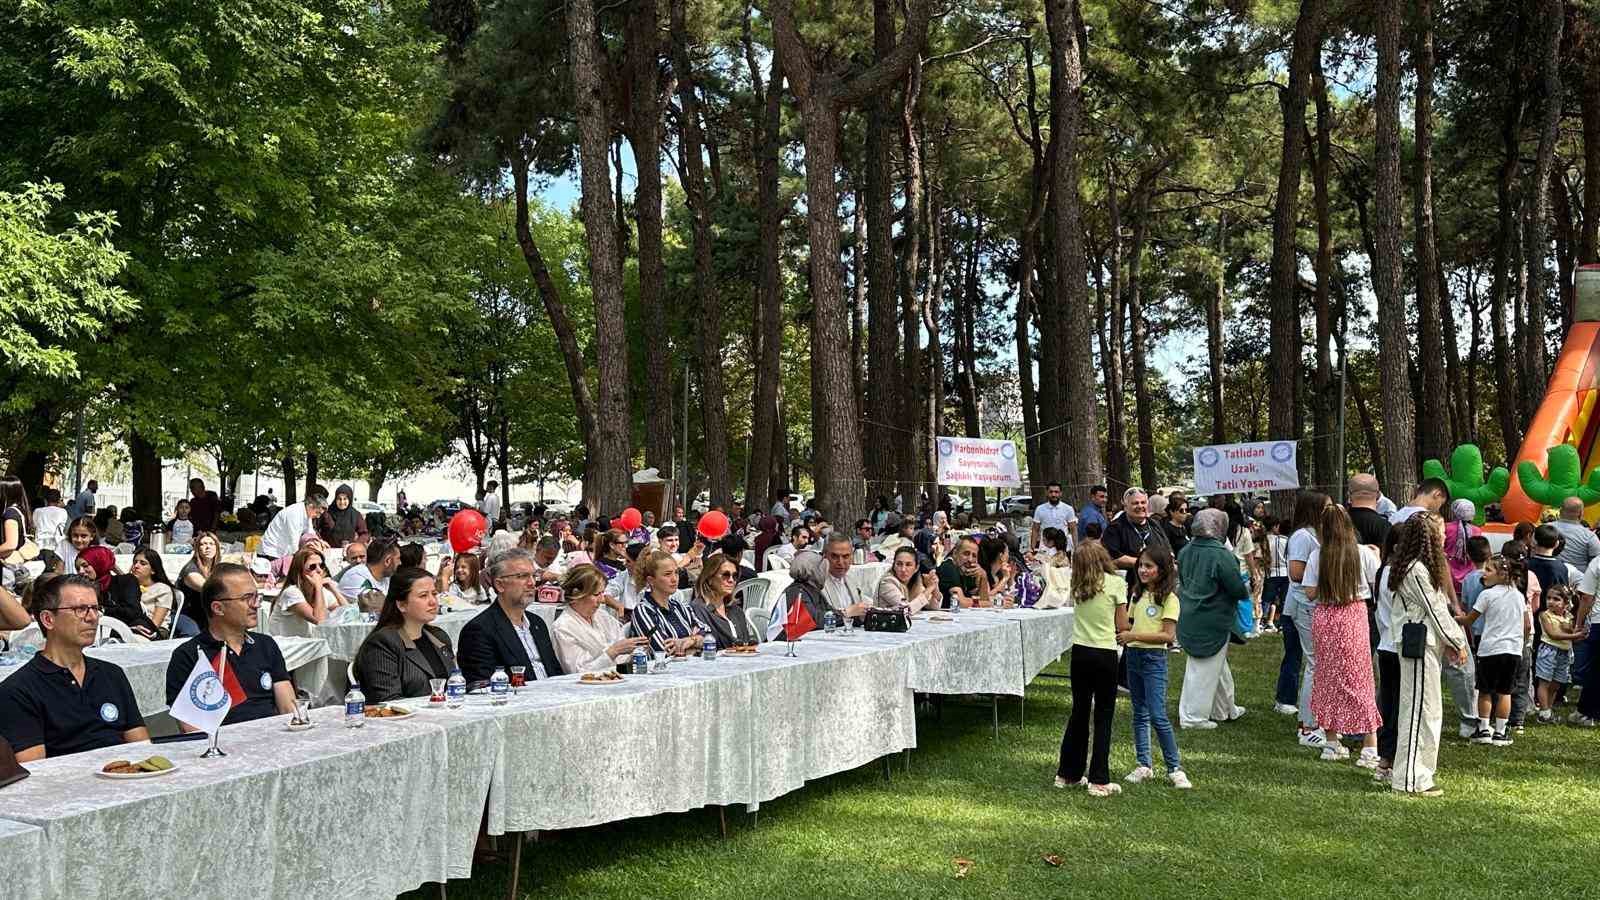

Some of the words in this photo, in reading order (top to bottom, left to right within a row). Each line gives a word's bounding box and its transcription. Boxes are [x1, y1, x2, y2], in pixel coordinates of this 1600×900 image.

[1223, 448, 1265, 459] Tatlıdan
[1231, 463, 1259, 474] Uzak,
[1215, 480, 1238, 490] Tatlı
